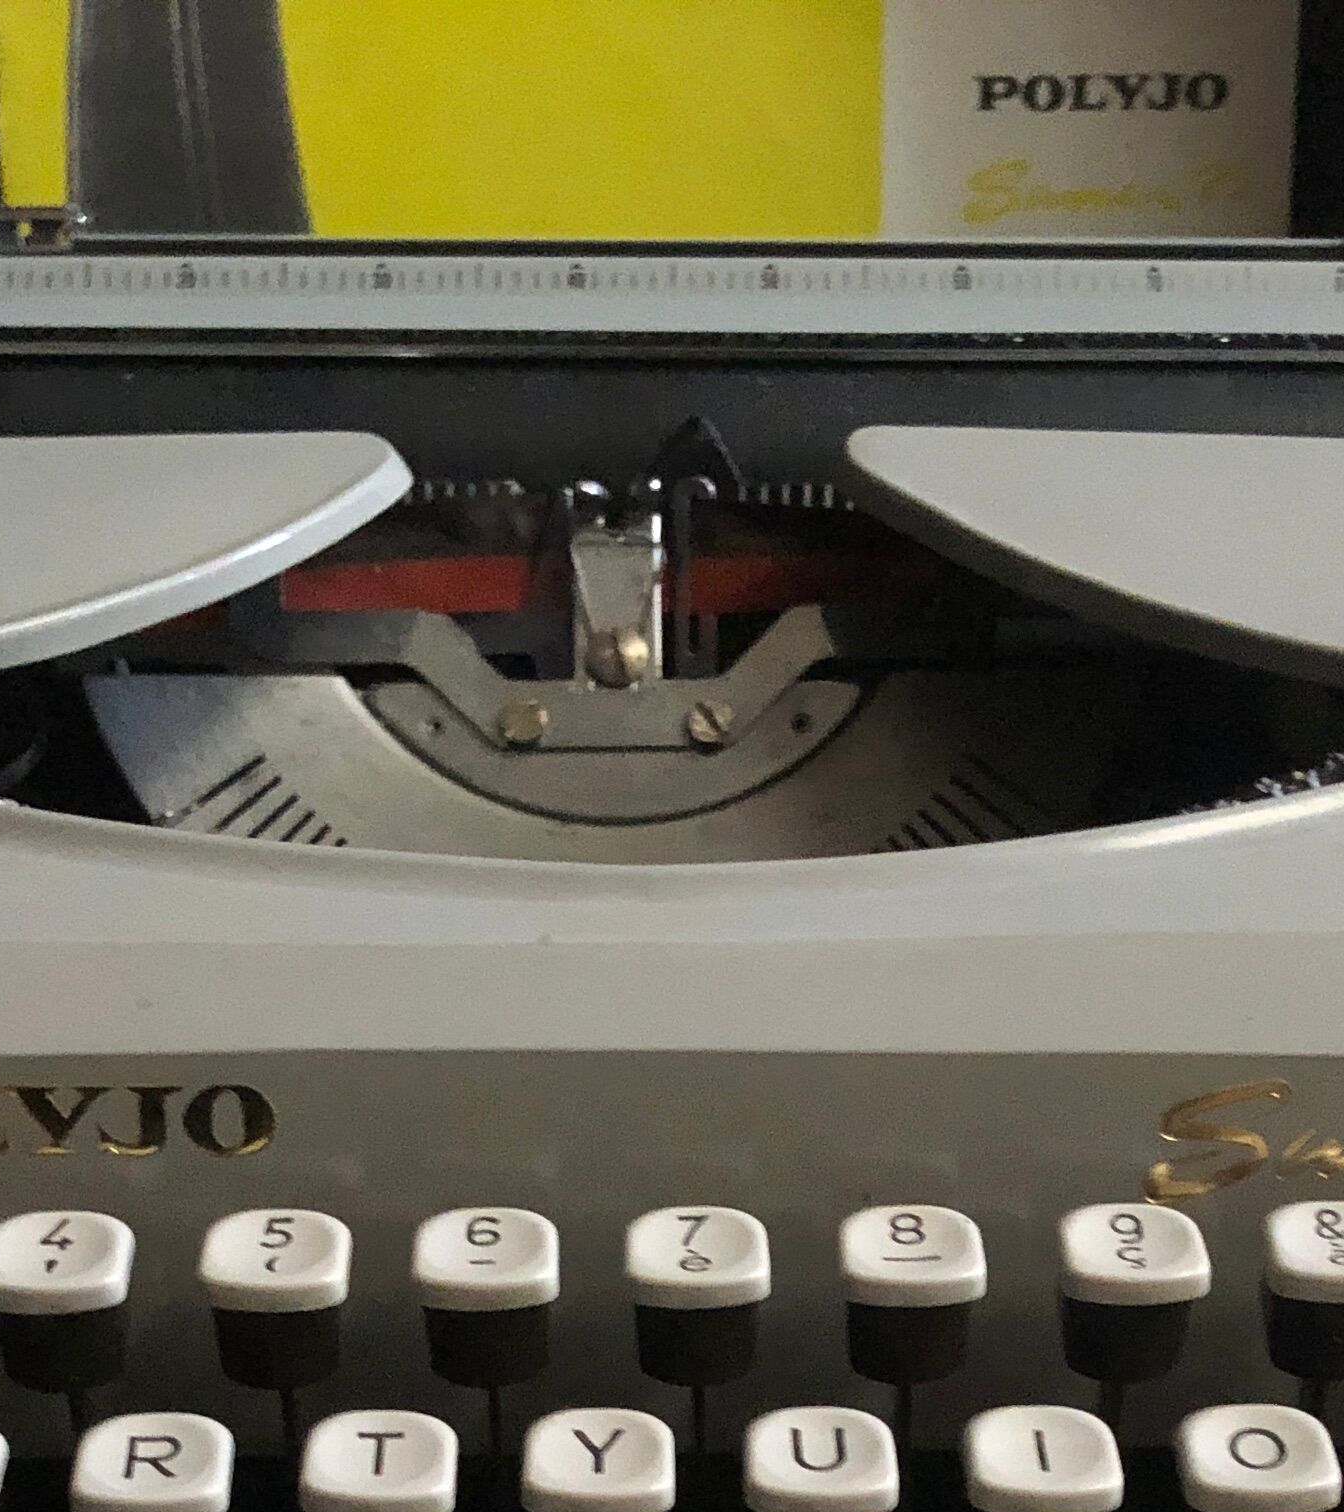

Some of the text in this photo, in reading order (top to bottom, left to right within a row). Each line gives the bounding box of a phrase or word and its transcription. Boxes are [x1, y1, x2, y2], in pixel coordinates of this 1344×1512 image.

[973, 73, 1229, 112] POLYJO
[39, 1218, 74, 1251] 4
[259, 1216, 295, 1250] 5
[465, 1215, 501, 1247] 6
[676, 1214, 709, 1247] 7
[889, 1212, 926, 1246] 8
[1109, 1212, 1145, 1245] 9
[123, 1435, 182, 1480] R
[356, 1431, 405, 1476] T
[572, 1428, 625, 1475] Y
[790, 1427, 847, 1472] U
[1033, 1429, 1050, 1472] I
[1228, 1427, 1288, 1471] O
